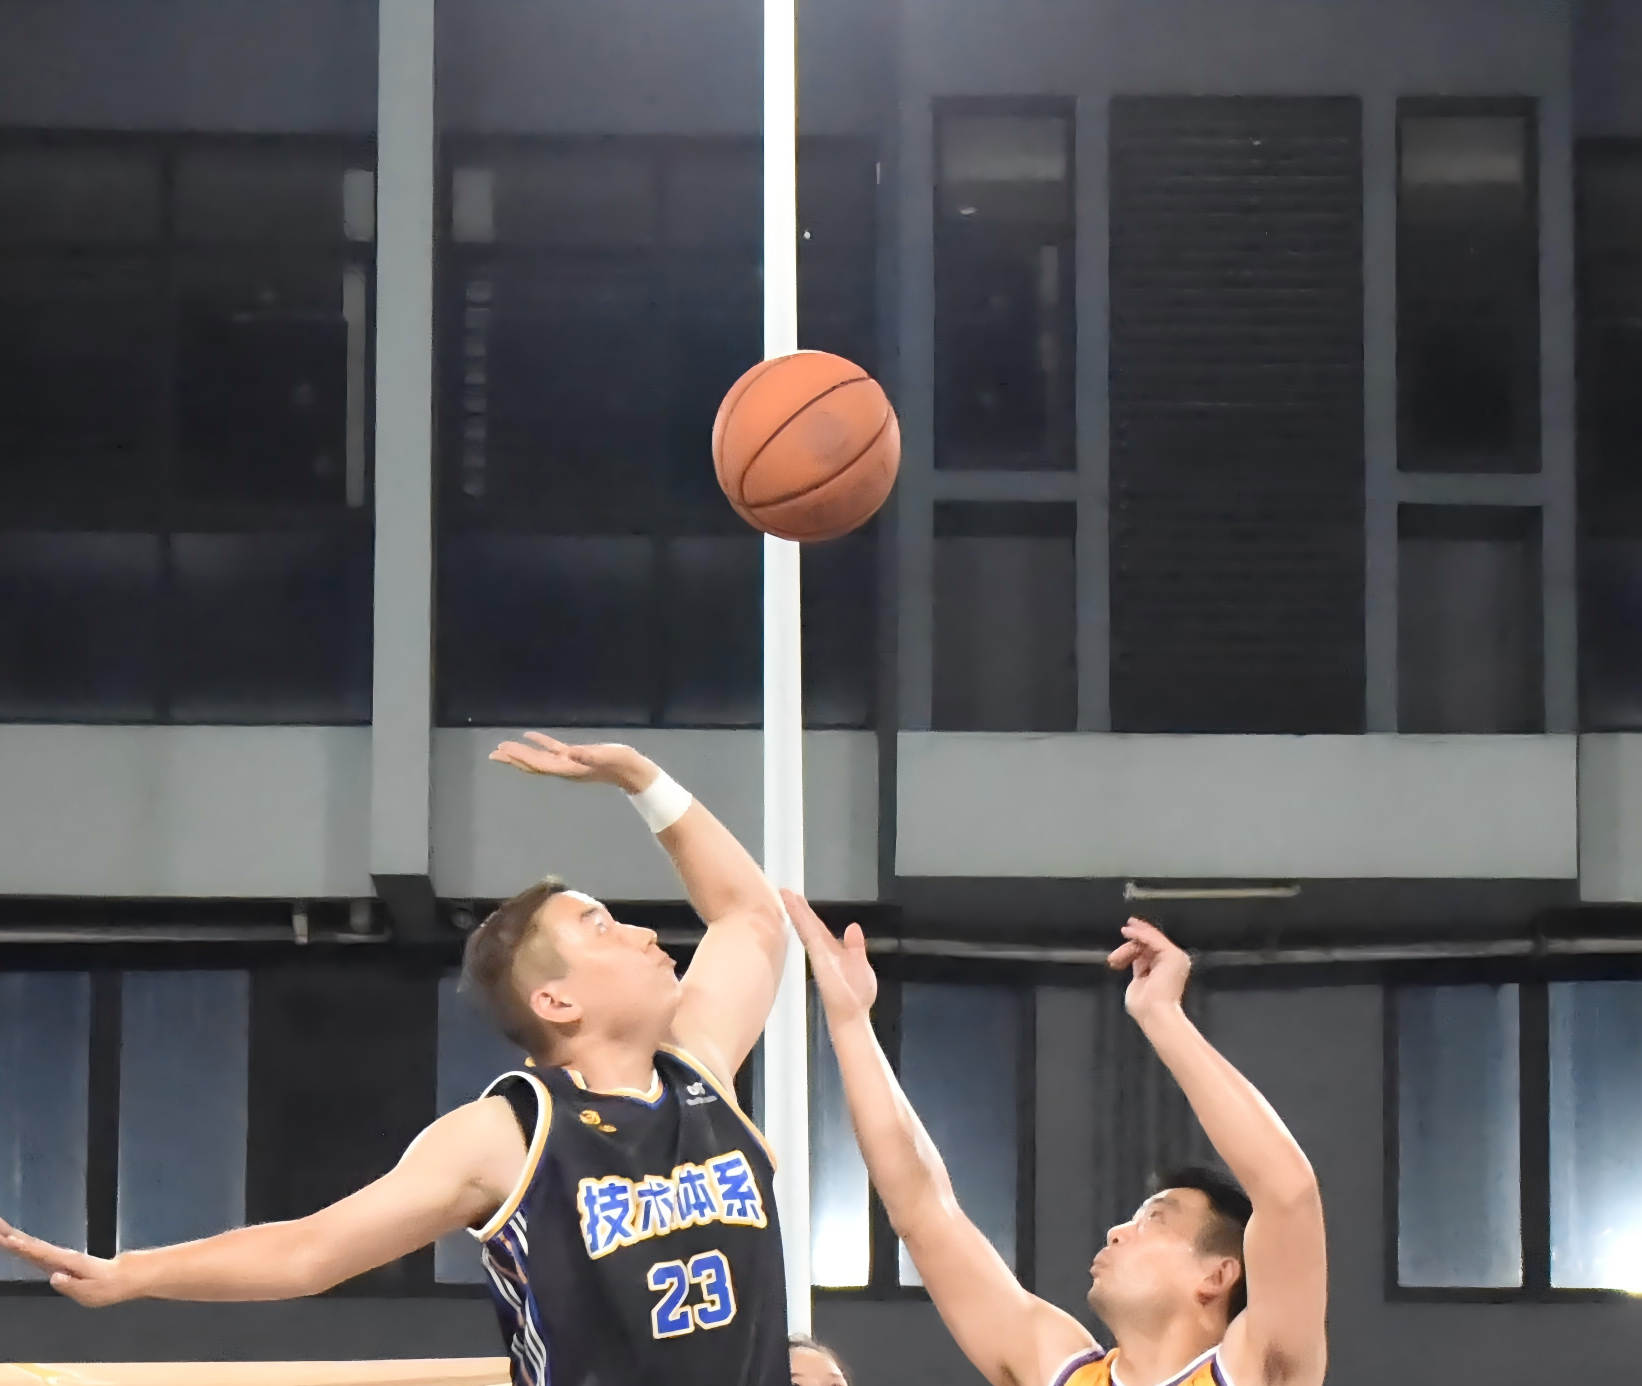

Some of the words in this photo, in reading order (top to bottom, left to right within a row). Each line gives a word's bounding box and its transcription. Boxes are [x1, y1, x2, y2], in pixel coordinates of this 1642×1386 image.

[577, 1150, 767, 1260] 技术体系
[647, 1249, 738, 1339] 23
